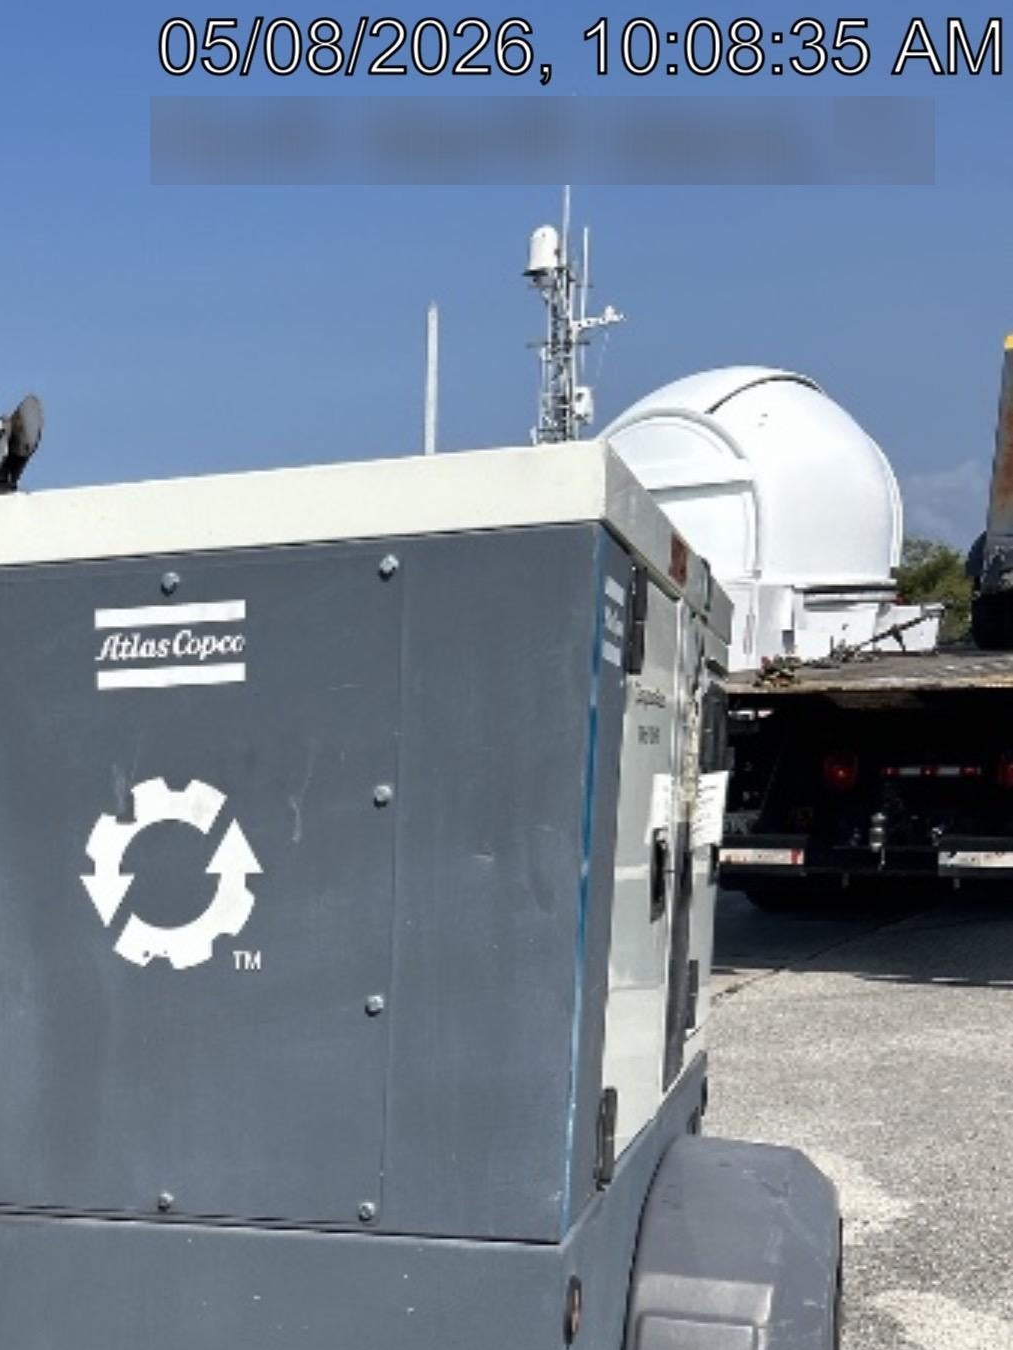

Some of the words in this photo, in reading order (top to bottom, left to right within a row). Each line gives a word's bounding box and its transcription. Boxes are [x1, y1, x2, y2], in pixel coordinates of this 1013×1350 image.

[95, 632, 171, 661] Atlas
[172, 629, 245, 660] Copco
[232, 950, 261, 970] TM
